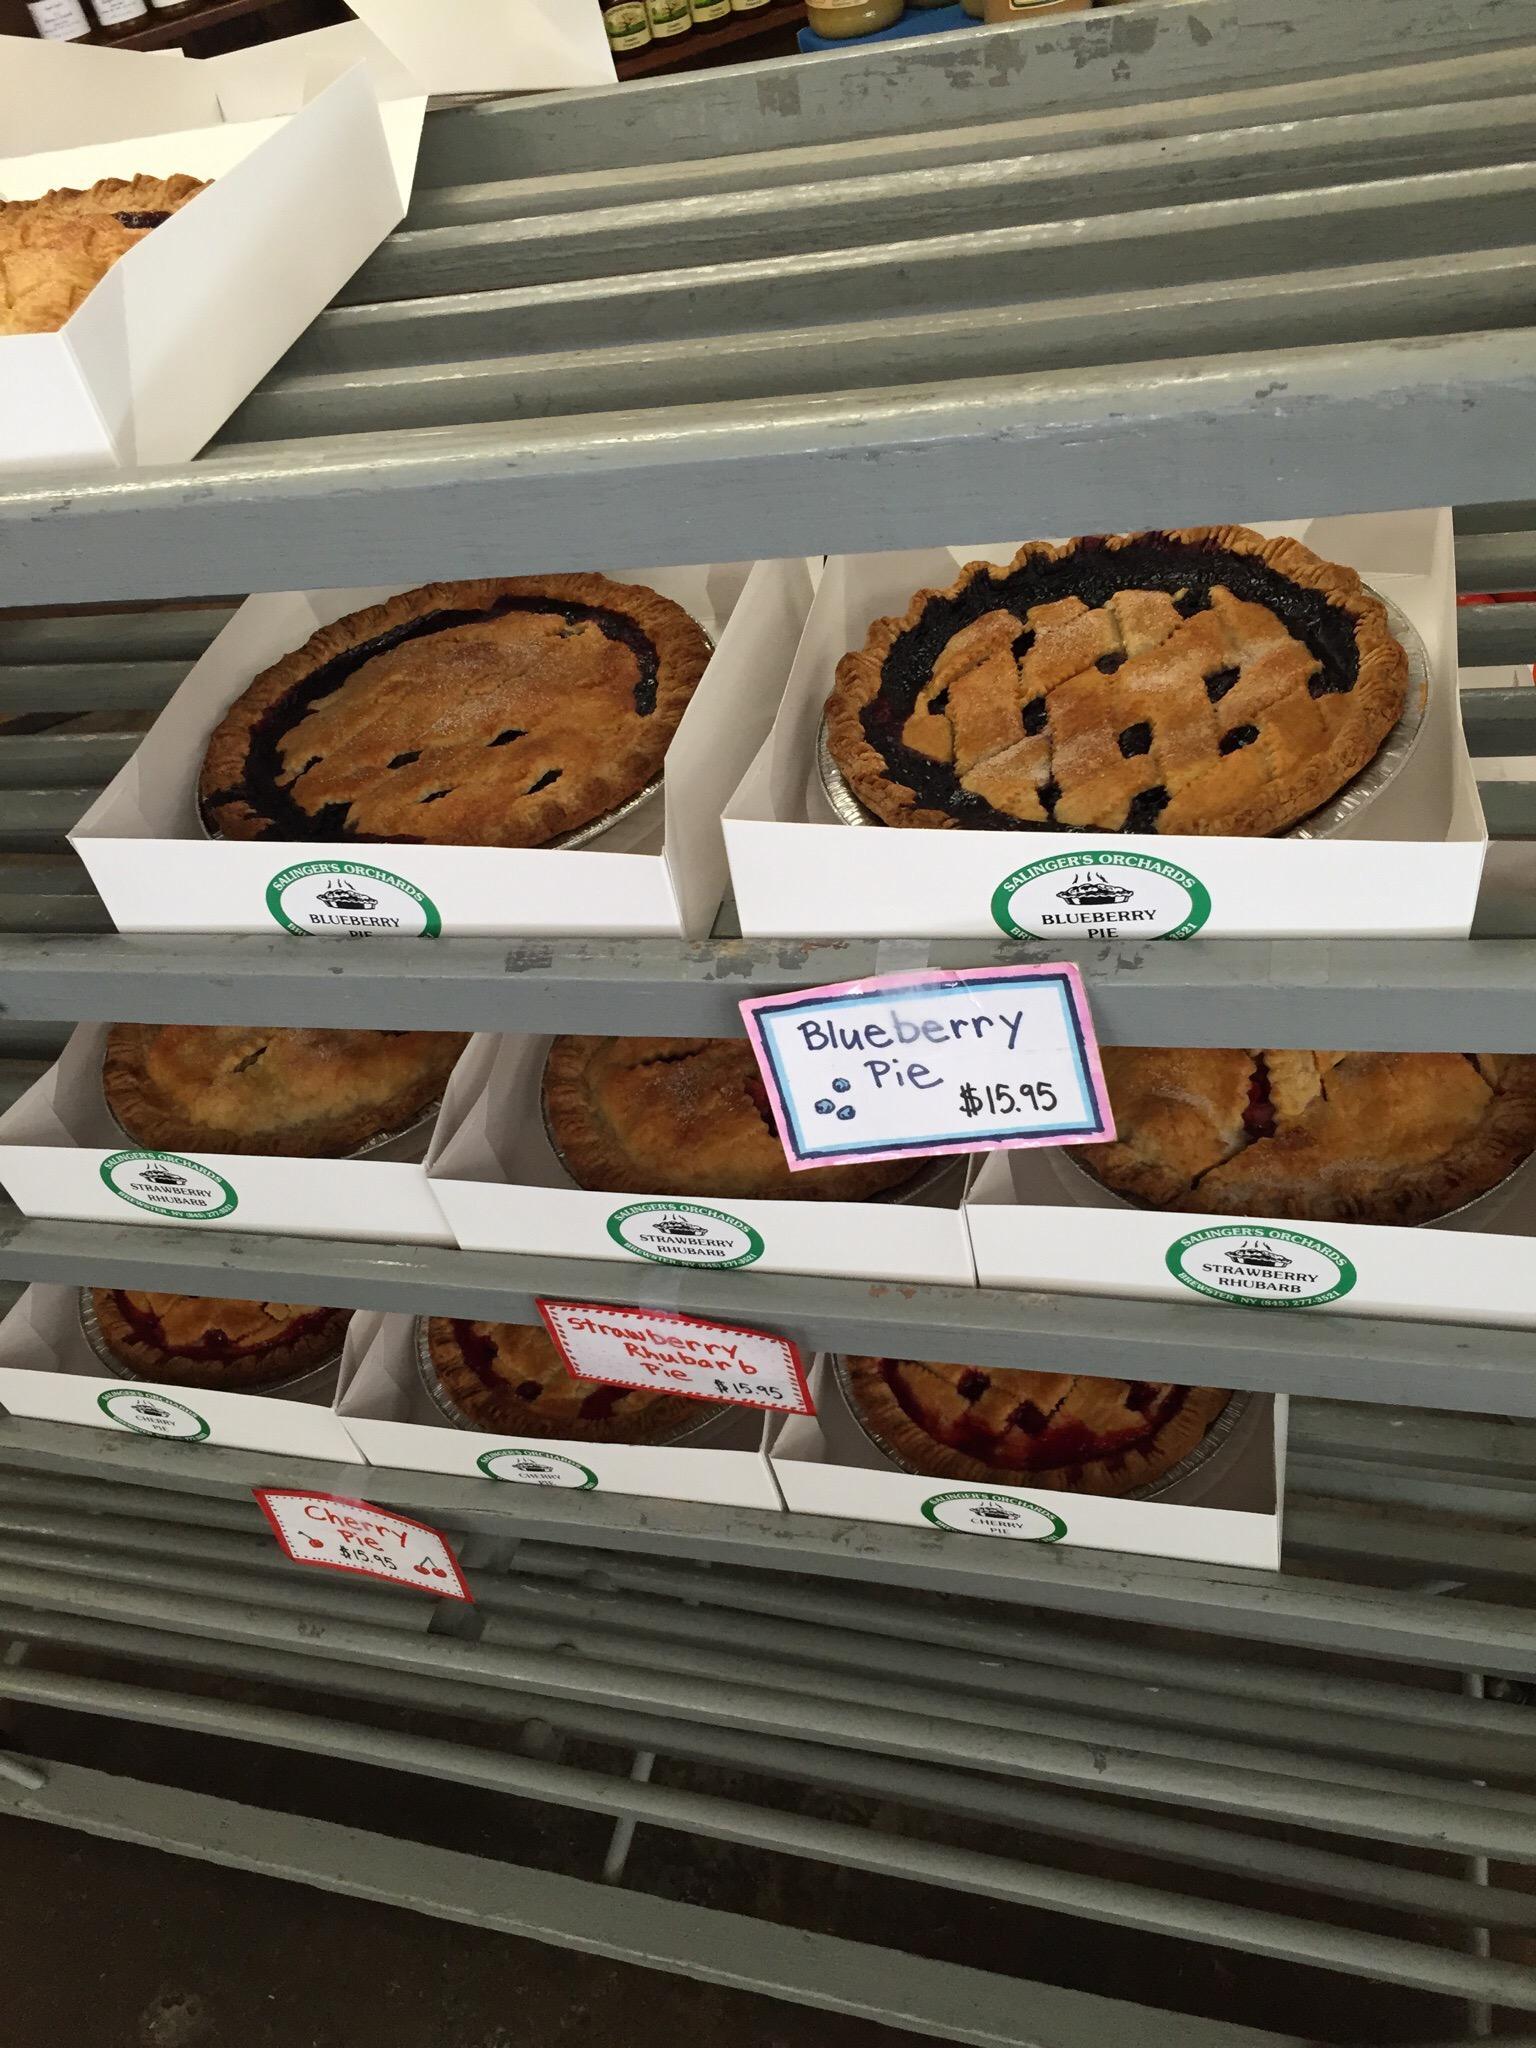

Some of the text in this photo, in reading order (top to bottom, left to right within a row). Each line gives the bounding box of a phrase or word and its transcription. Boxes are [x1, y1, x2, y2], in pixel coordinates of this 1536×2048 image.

[272, 863, 424, 902] SALINGER'S ORCHARDS
[1003, 853, 1196, 892] SALINGER'S ORCHARDS
[309, 913, 400, 927] BLUEBERRY
[1041, 909, 1157, 925] BLUEBERRY
[1087, 927, 1119, 939] PIE
[797, 1010, 1024, 1051] Blueberry
[864, 1058, 945, 1089] Pie
[959, 1081, 1058, 1118] $15.95
[104, 1152, 224, 1183] SALINGER'S ORCHARDS
[130, 1182, 212, 1198] STRAWBERRY
[147, 1193, 208, 1207] RHUBARB
[613, 1203, 750, 1233] SALINGER'S ORCHARDS
[639, 1234, 735, 1248] STRAWBERRY
[657, 1245, 726, 1257] RHUBARB
[1180, 1227, 1347, 1267] SALINGER'S ORCHARDS
[1202, 1263, 1319, 1283] STRAWBERRY
[1218, 1277, 1302, 1293] RHUBARB
[1260, 1299, 1289, 1307] (845)
[1292, 1290, 1341, 1306] 277-3521
[567, 1317, 739, 1360] Strawberry
[623, 1341, 758, 1375] Rhubarb
[640, 1362, 693, 1382] Pie
[713, 1378, 784, 1400] $15.95
[135, 1415, 176, 1427] CHERRY
[304, 1505, 408, 1548] Cherry
[970, 1518, 1024, 1529] CHERRY
[337, 1529, 385, 1552] Pie
[339, 1545, 398, 1570] $15.95
